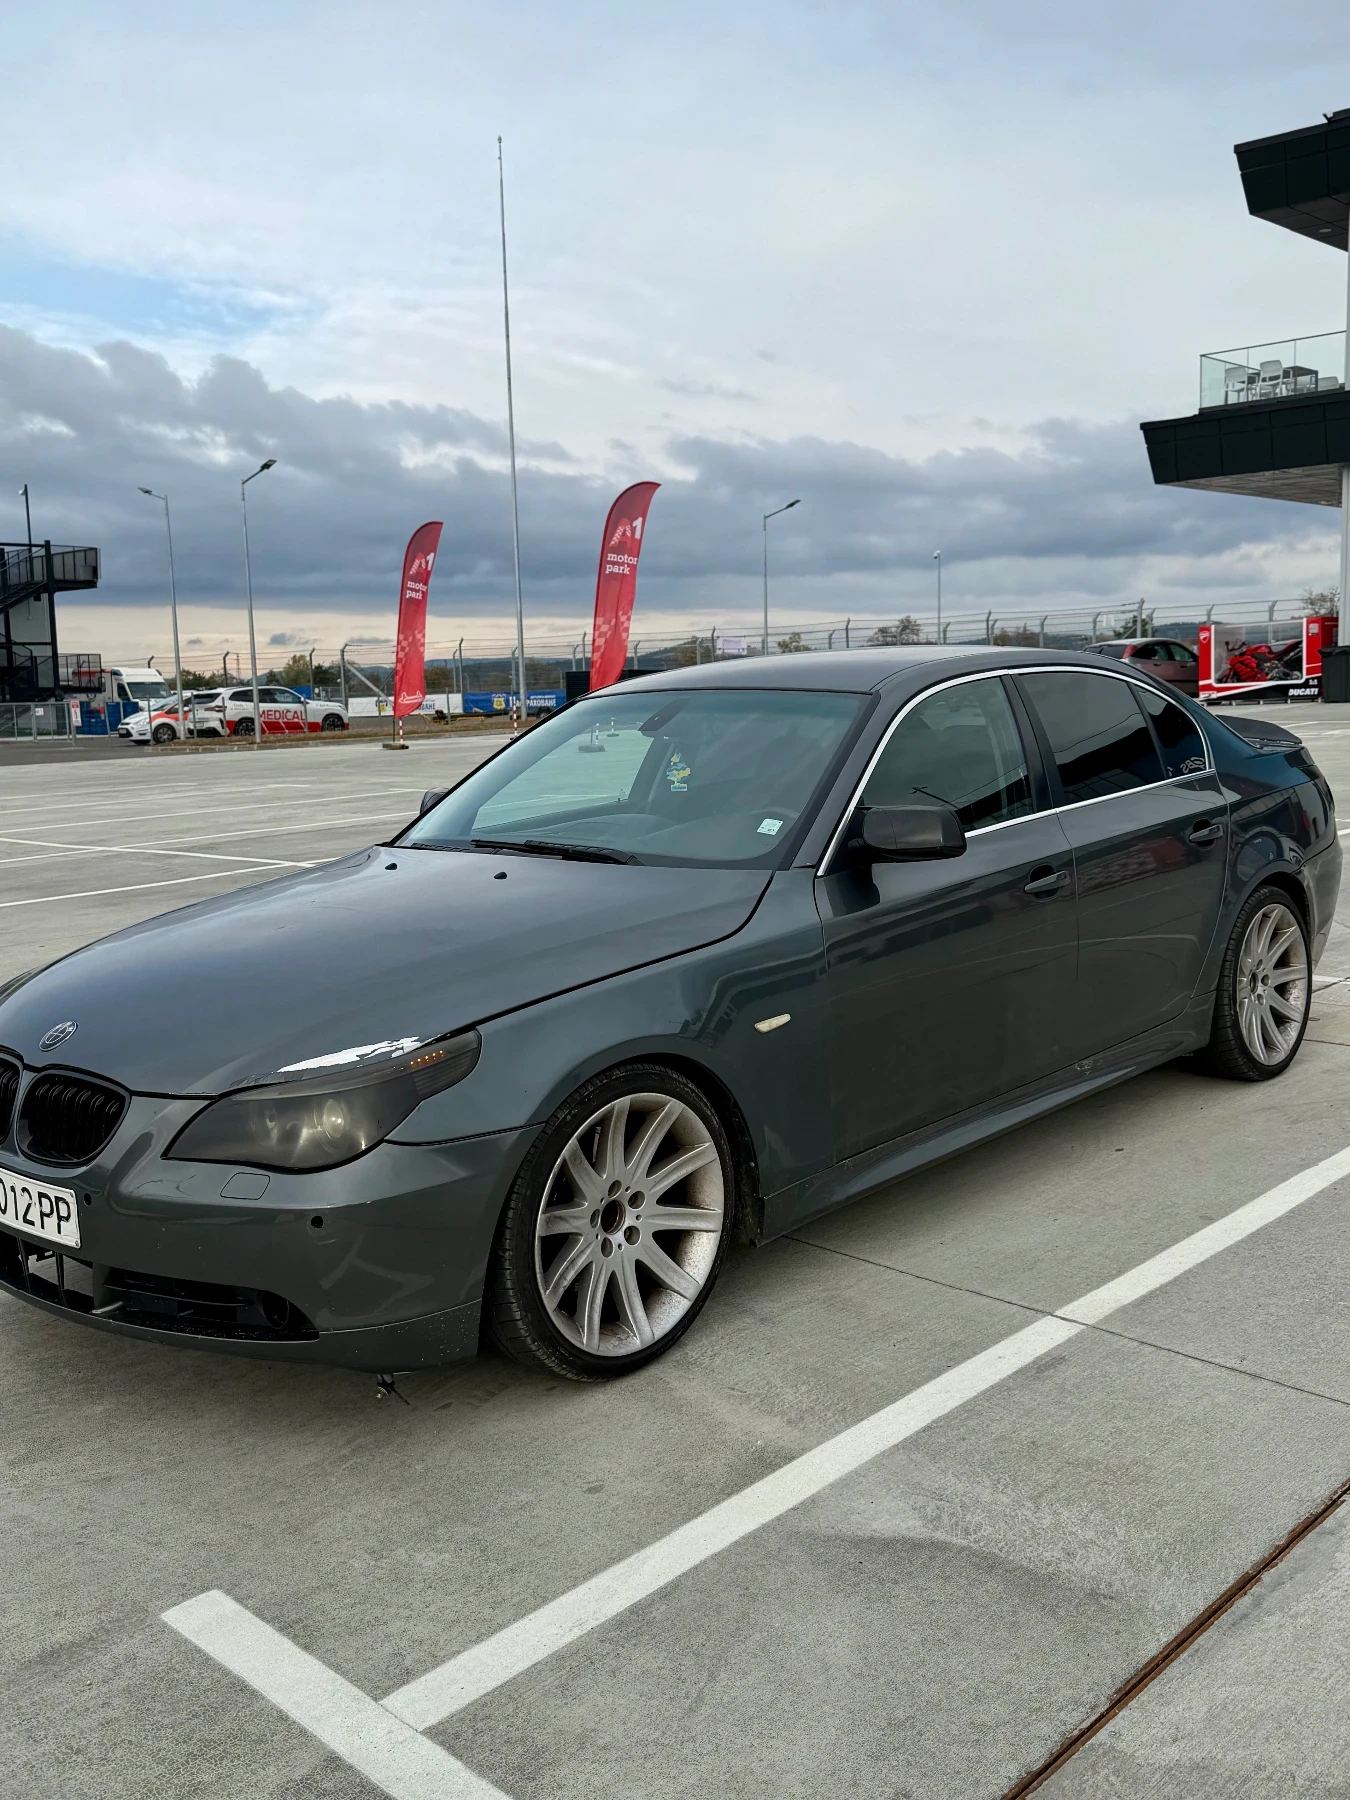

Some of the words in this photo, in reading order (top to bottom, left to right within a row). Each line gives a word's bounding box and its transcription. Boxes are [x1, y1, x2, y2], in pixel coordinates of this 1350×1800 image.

[607, 553, 639, 564] motor
[605, 564, 630, 574] park
[407, 581, 427, 591] motor
[406, 589, 423, 600] park
[1288, 688, 1319, 696] DUCATI
[260, 709, 305, 721] MEDICAL
